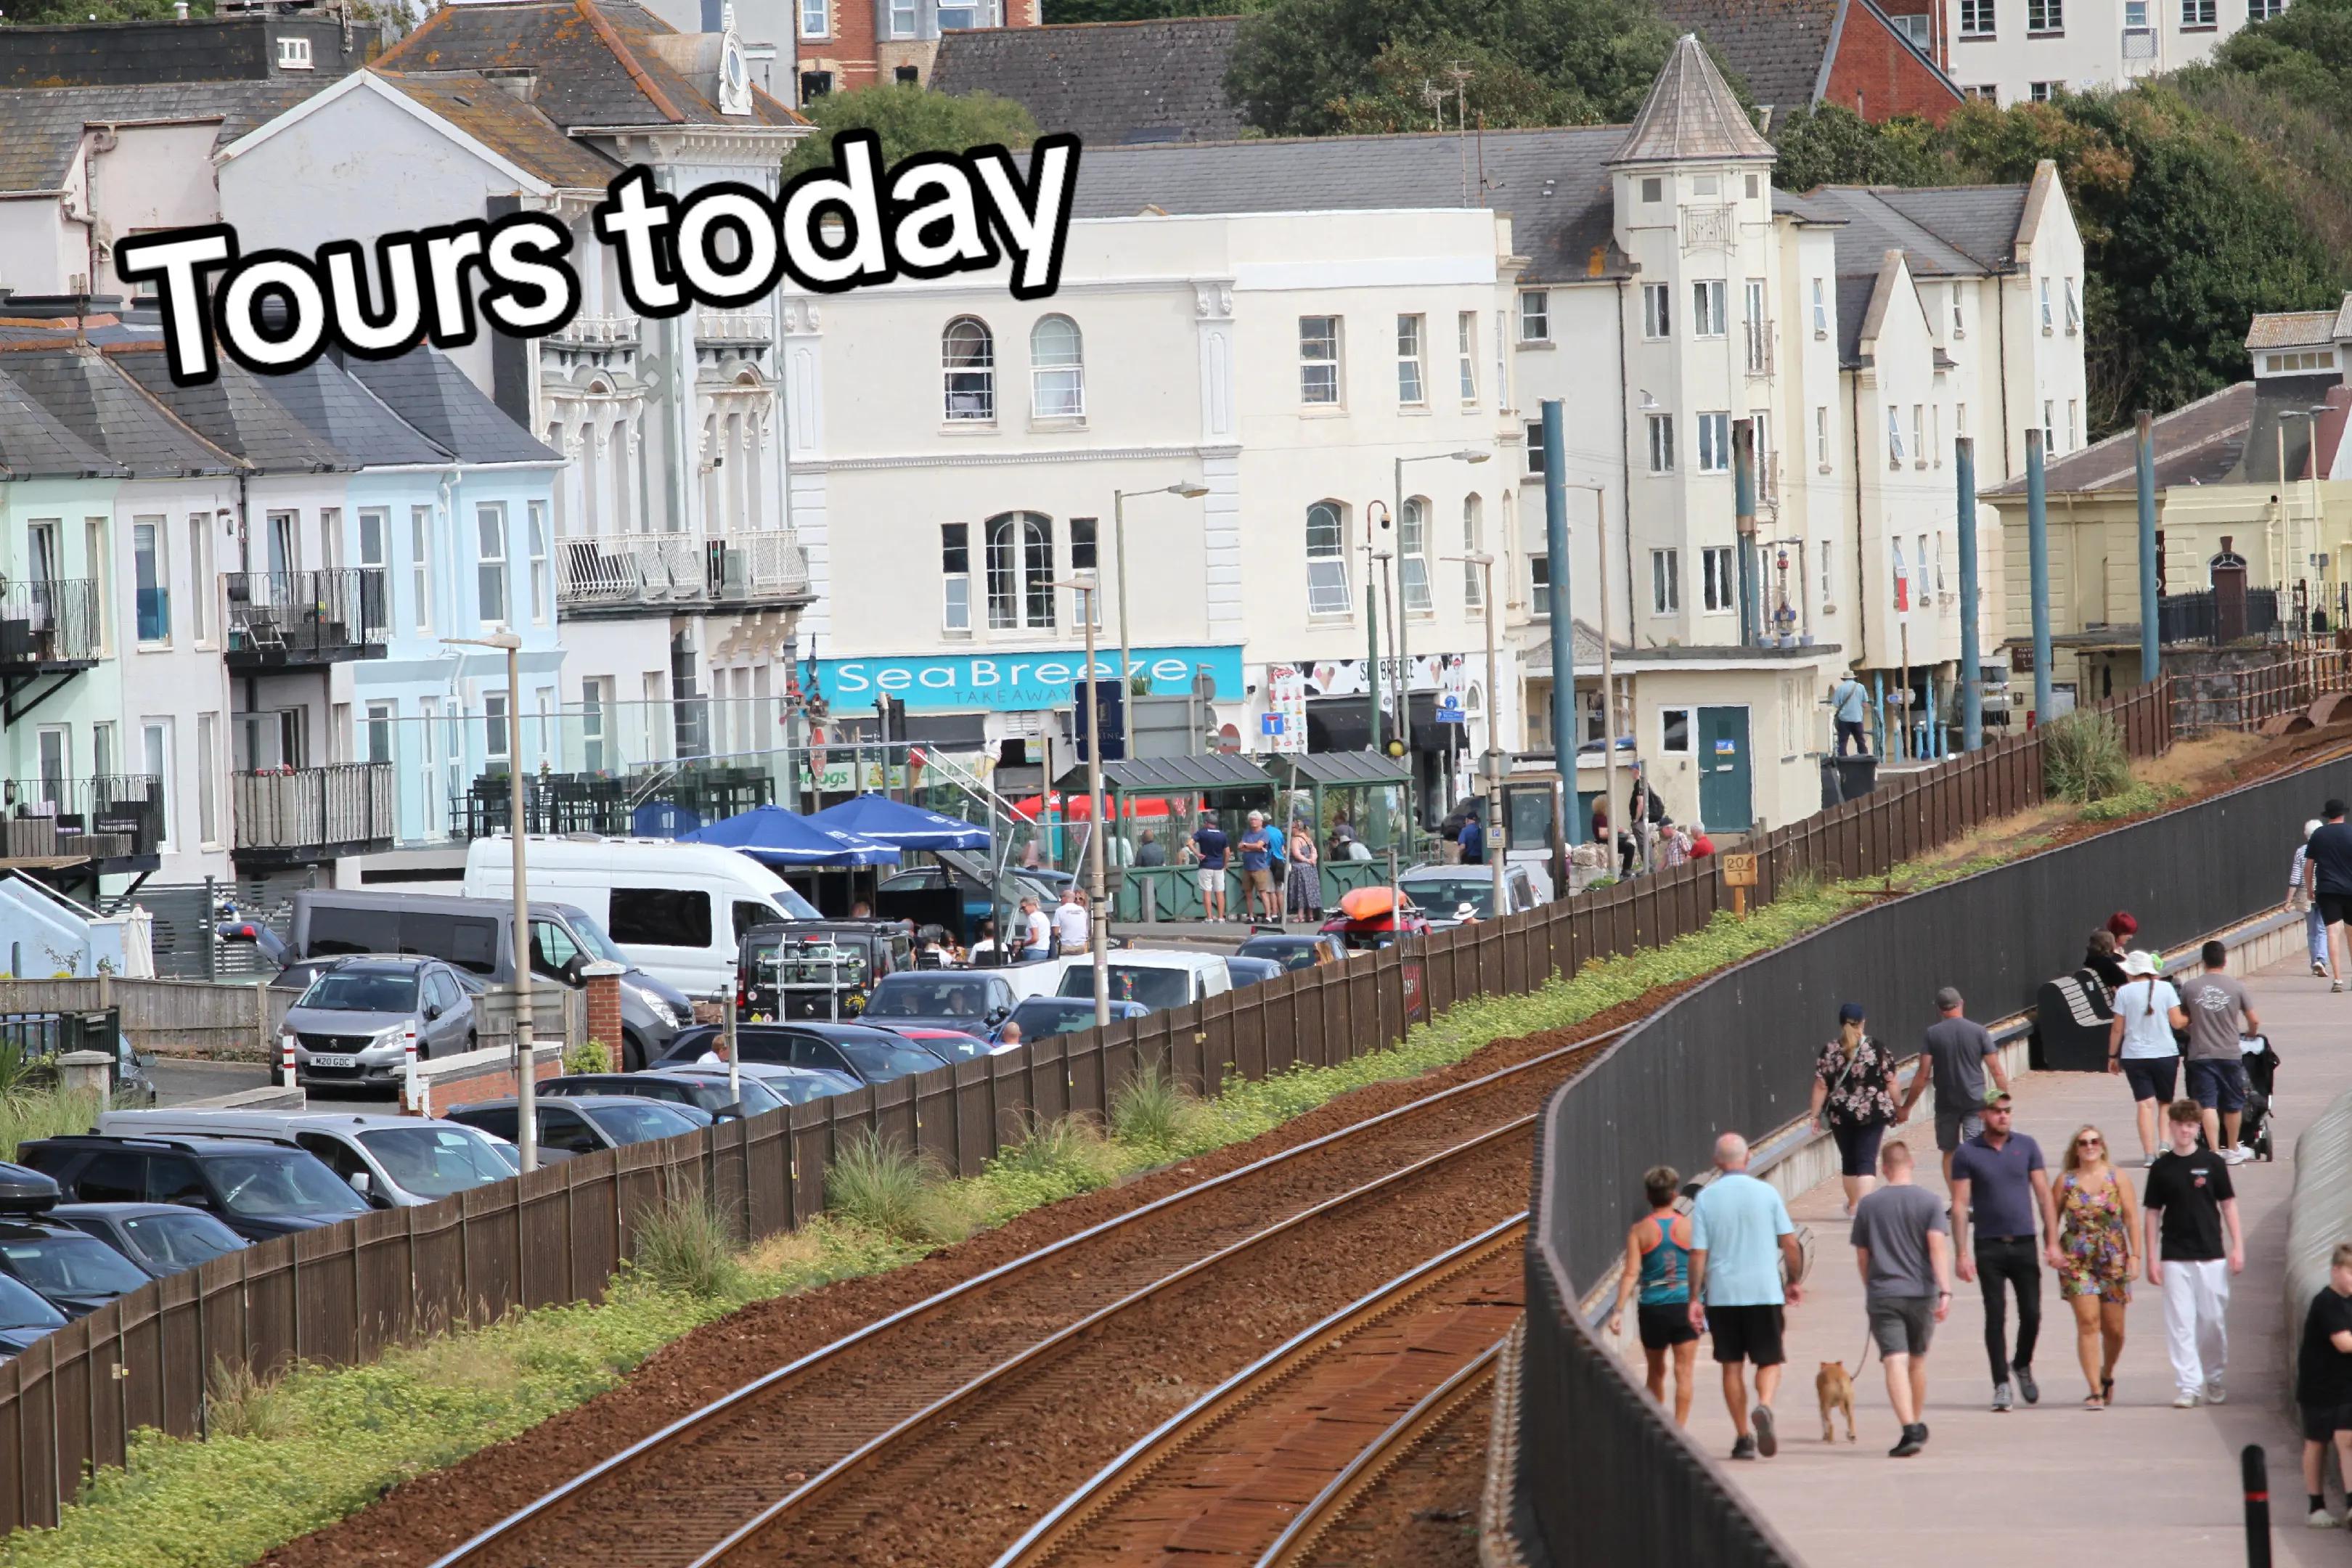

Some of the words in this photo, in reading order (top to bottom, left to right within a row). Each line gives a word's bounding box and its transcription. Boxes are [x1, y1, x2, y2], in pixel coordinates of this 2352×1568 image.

[837, 663, 956, 693] Sea
[955, 688, 1071, 704] TAKEAWAY
[316, 1057, 332, 1066] M20
[333, 1058, 350, 1066] GDC
